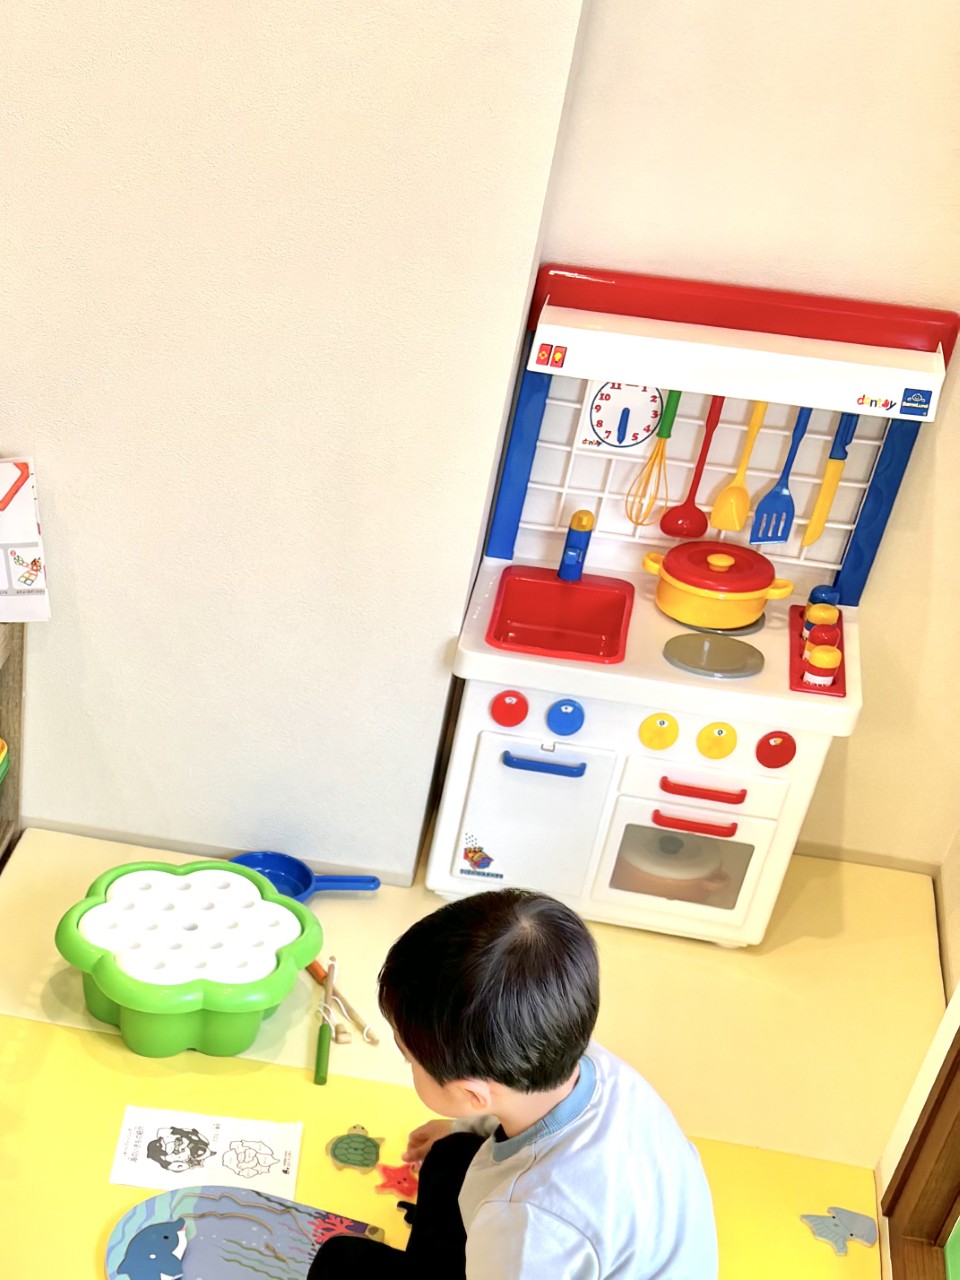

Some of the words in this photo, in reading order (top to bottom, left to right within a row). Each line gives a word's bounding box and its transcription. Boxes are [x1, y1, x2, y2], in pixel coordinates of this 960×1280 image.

[610, 382, 622, 390] 11
[599, 393, 611, 401] 10
[650, 395, 658, 403] 2
[594, 404, 602, 413] 9
[651, 410, 659, 418] 3
[596, 420, 604, 428] 8
[643, 424, 651, 433] 4
[604, 430, 612, 439] 7
[631, 433, 639, 441] 5
